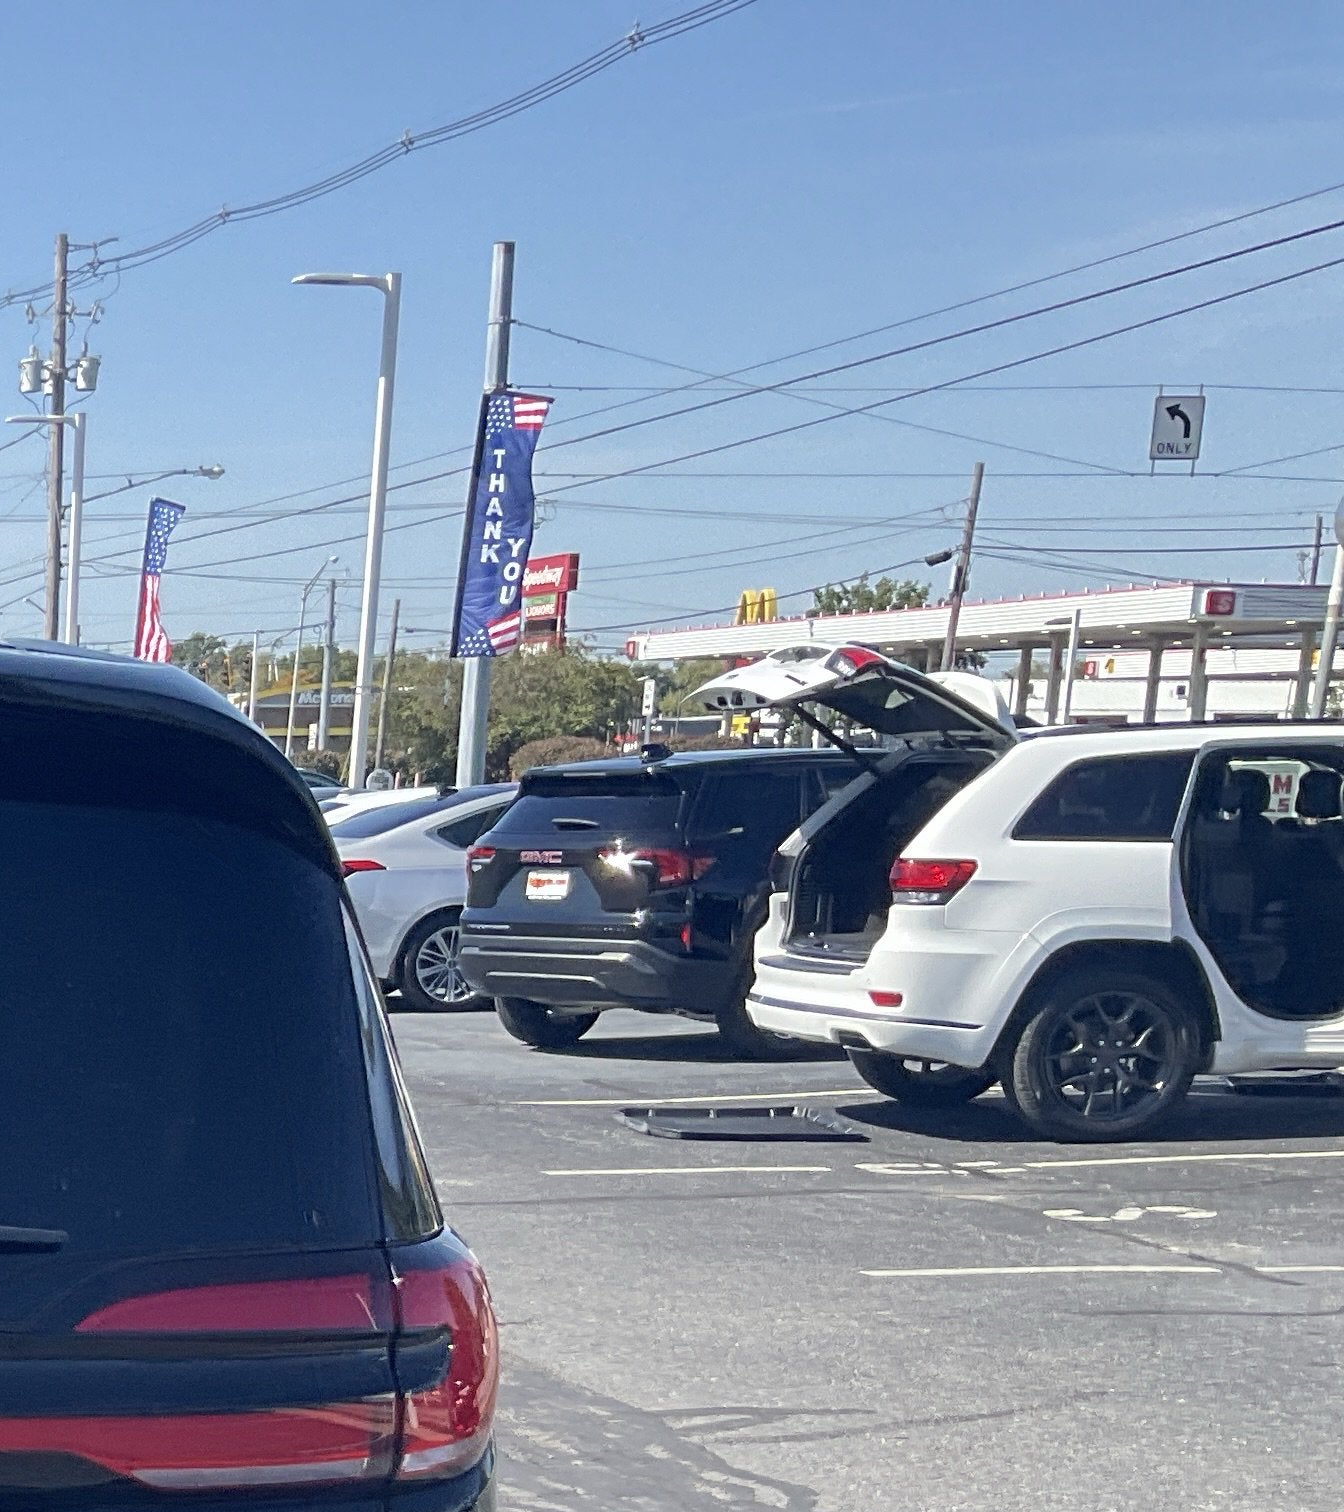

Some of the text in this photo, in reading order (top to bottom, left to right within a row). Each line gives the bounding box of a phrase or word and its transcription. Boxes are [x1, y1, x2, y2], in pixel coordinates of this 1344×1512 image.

[1156, 442, 1192, 455] ONLY
[480, 448, 506, 564] THANK
[499, 537, 525, 605] YOU
[520, 850, 563, 864] GMC
